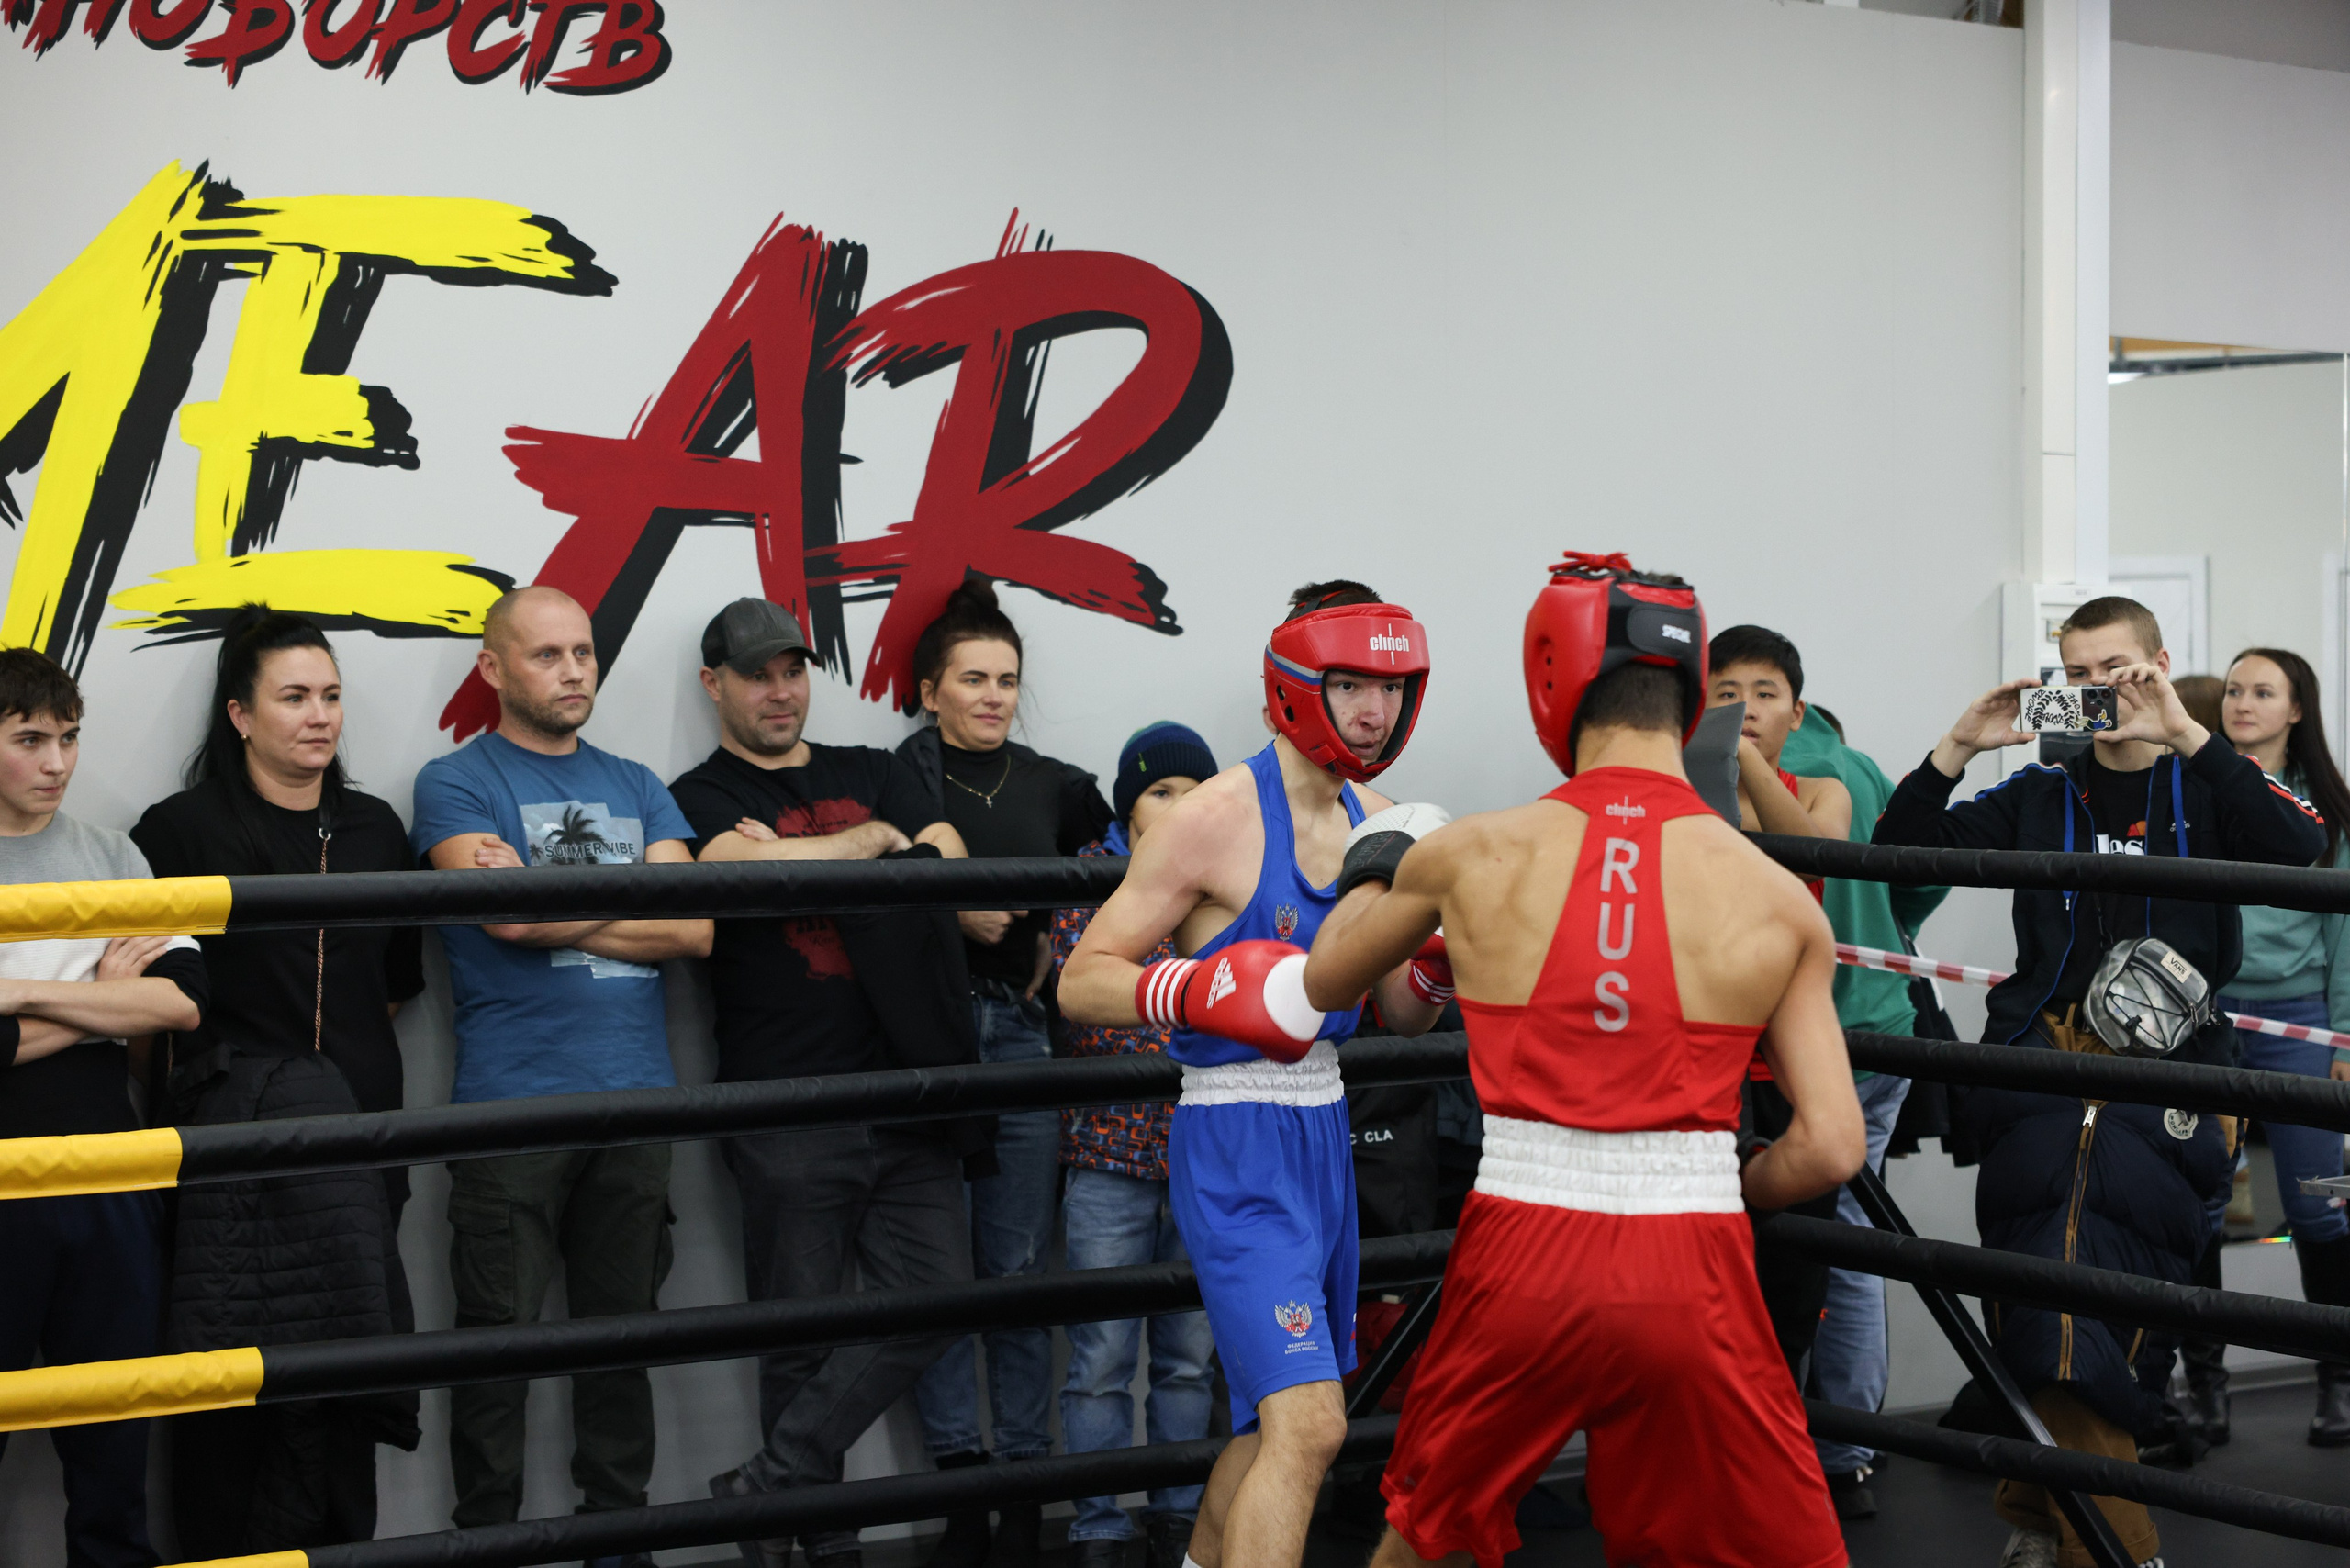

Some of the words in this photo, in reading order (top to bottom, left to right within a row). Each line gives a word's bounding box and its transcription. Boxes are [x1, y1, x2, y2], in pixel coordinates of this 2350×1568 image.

[1370, 633, 1409, 652] clinch
[1606, 802, 1646, 818] clinch
[606, 842, 636, 855] VIBE
[1593, 837, 1640, 1032] RUS
[1364, 1129, 1393, 1143] CLA
